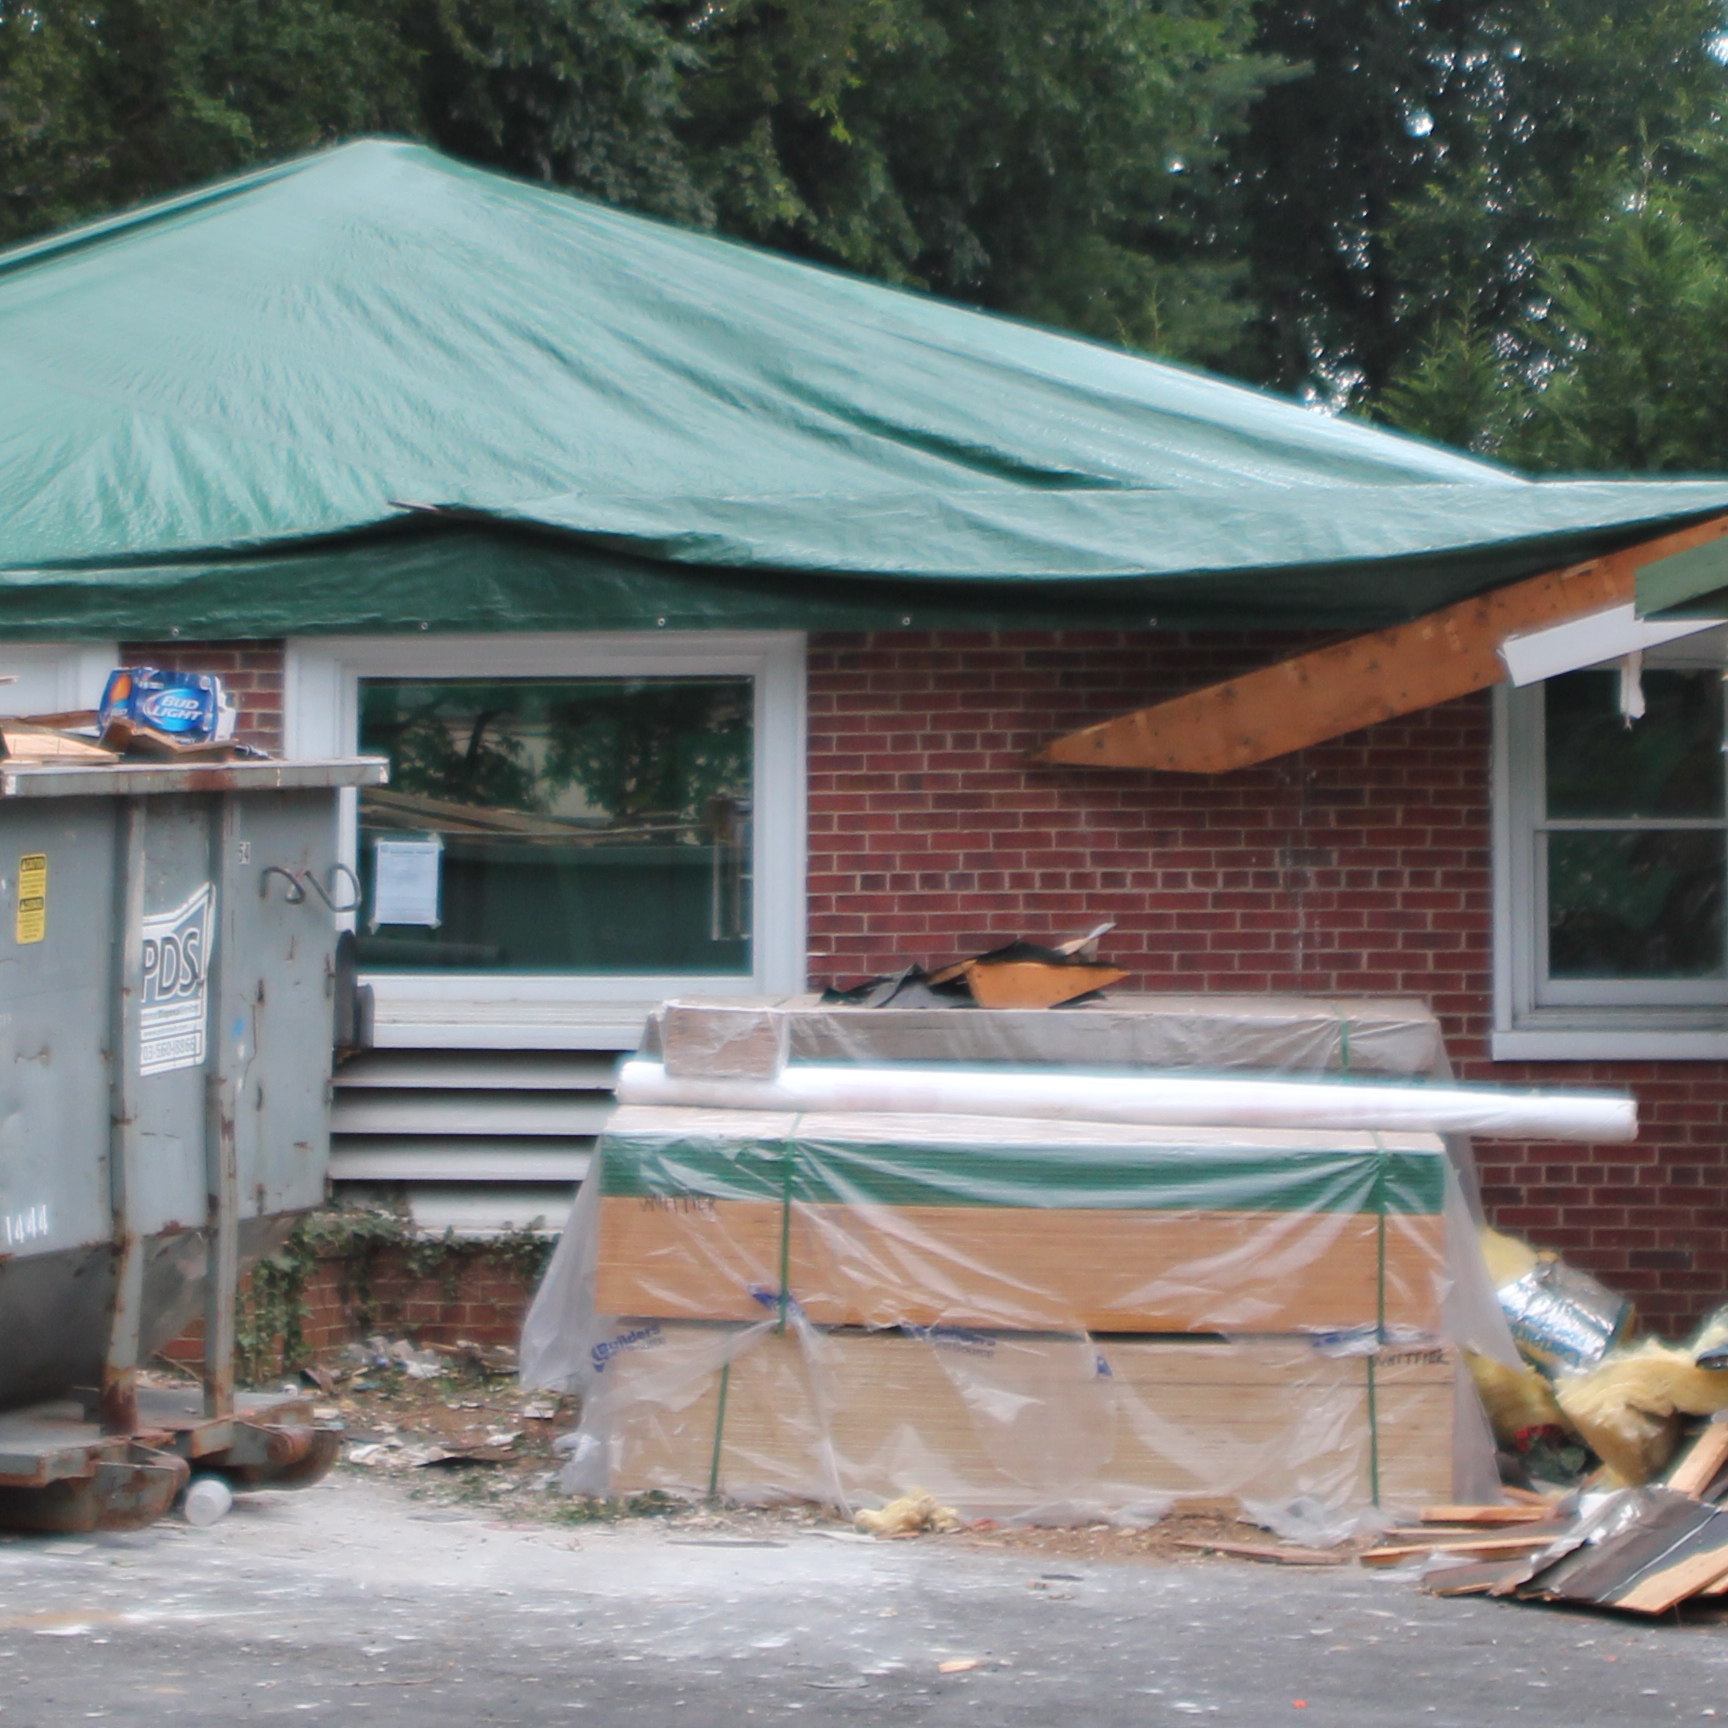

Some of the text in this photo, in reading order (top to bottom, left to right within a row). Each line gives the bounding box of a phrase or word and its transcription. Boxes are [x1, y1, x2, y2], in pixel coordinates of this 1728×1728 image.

[151, 706, 203, 721] LIGHT
[161, 695, 199, 710] BUD
[142, 927, 200, 1003] PDS
[5, 1203, 48, 1246] 1444
